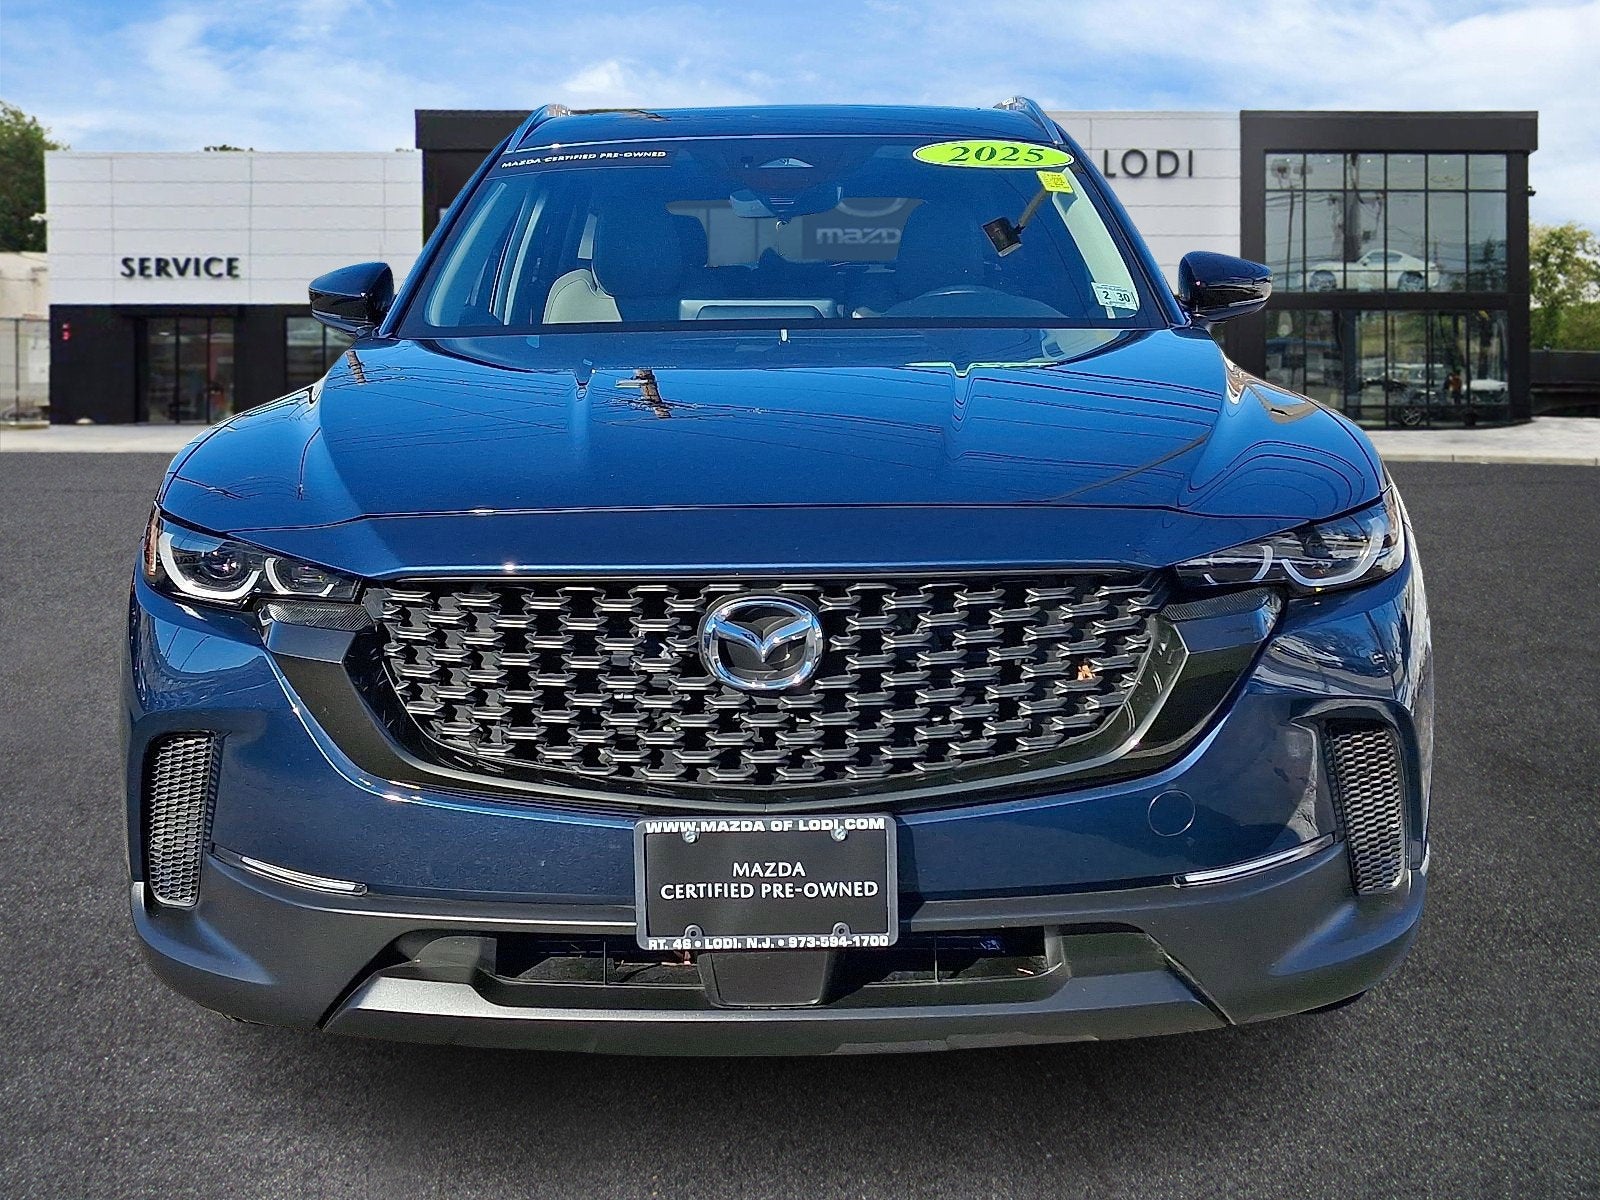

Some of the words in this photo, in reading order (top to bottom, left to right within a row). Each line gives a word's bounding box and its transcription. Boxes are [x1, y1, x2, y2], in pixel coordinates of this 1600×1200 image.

[501, 157, 542, 169] MAZDA
[542, 153, 597, 163] CERTIFIED
[599, 150, 667, 160] PRE-OWNED
[948, 145, 1045, 163] 2025
[1103, 149, 1193, 178] LODI
[120, 256, 241, 279] SERVICE
[1102, 290, 1111, 300] 2
[1116, 292, 1131, 303] 30
[645, 820, 766, 834] WWW.MAZDA
[770, 819, 793, 832] OF
[798, 818, 885, 832] LODI.COM
[732, 862, 806, 878] MAZDA
[660, 883, 755, 900] CERTIFIED
[760, 881, 879, 898] PRE-OWNED
[648, 939, 668, 950] RT.
[672, 939, 692, 950] 46
[746, 938, 775, 949] N.J.
[788, 936, 889, 948] 973-594-1700
